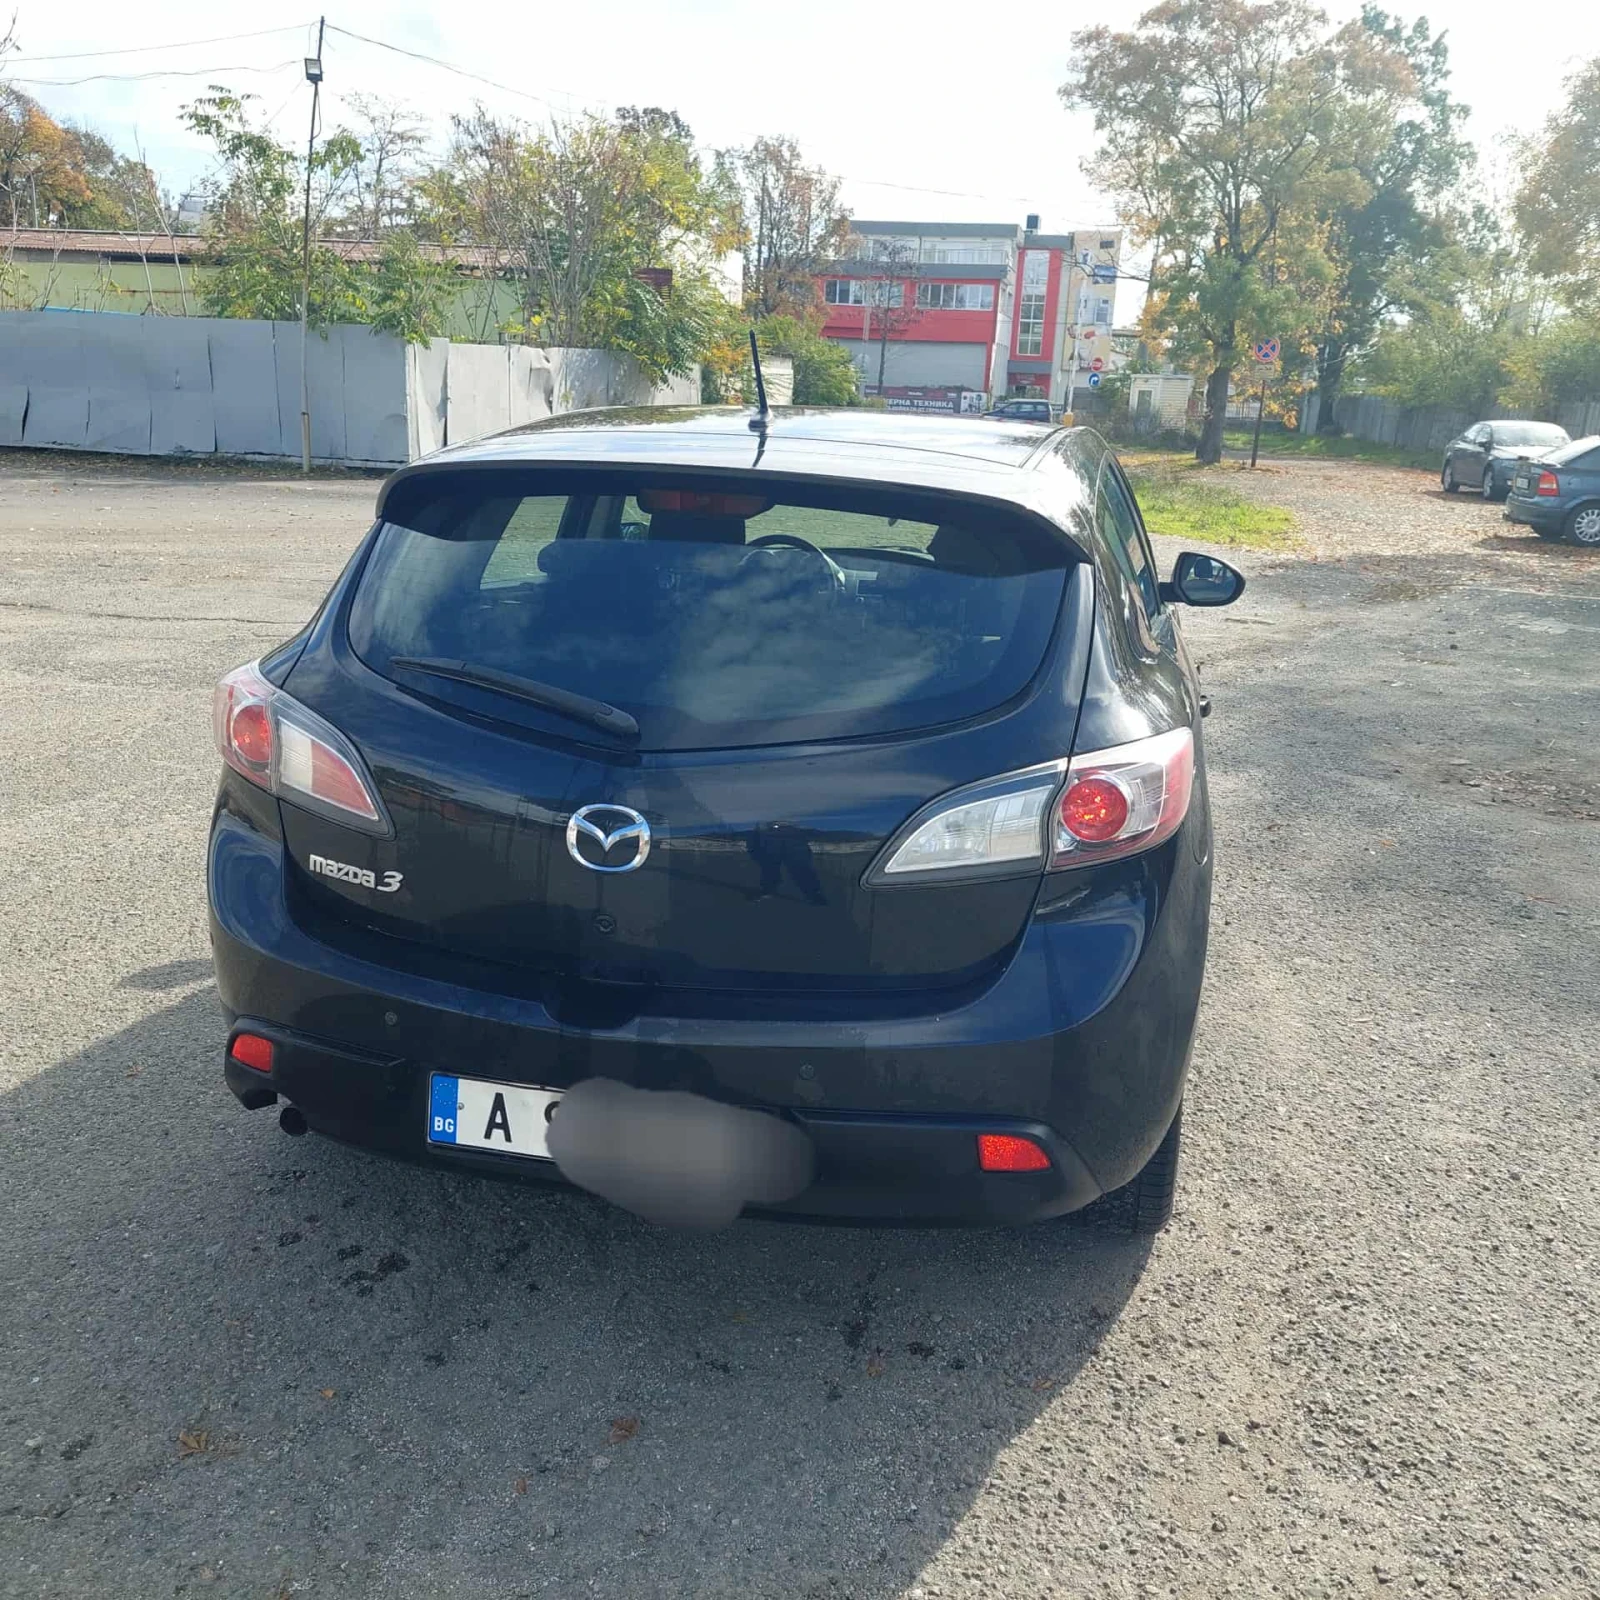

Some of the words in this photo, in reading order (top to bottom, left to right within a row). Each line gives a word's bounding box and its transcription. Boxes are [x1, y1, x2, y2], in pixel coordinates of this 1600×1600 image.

[913, 399, 953, 408] ТЕХНИКА
[434, 1116, 455, 1133] BG
[484, 1092, 513, 1143] A
